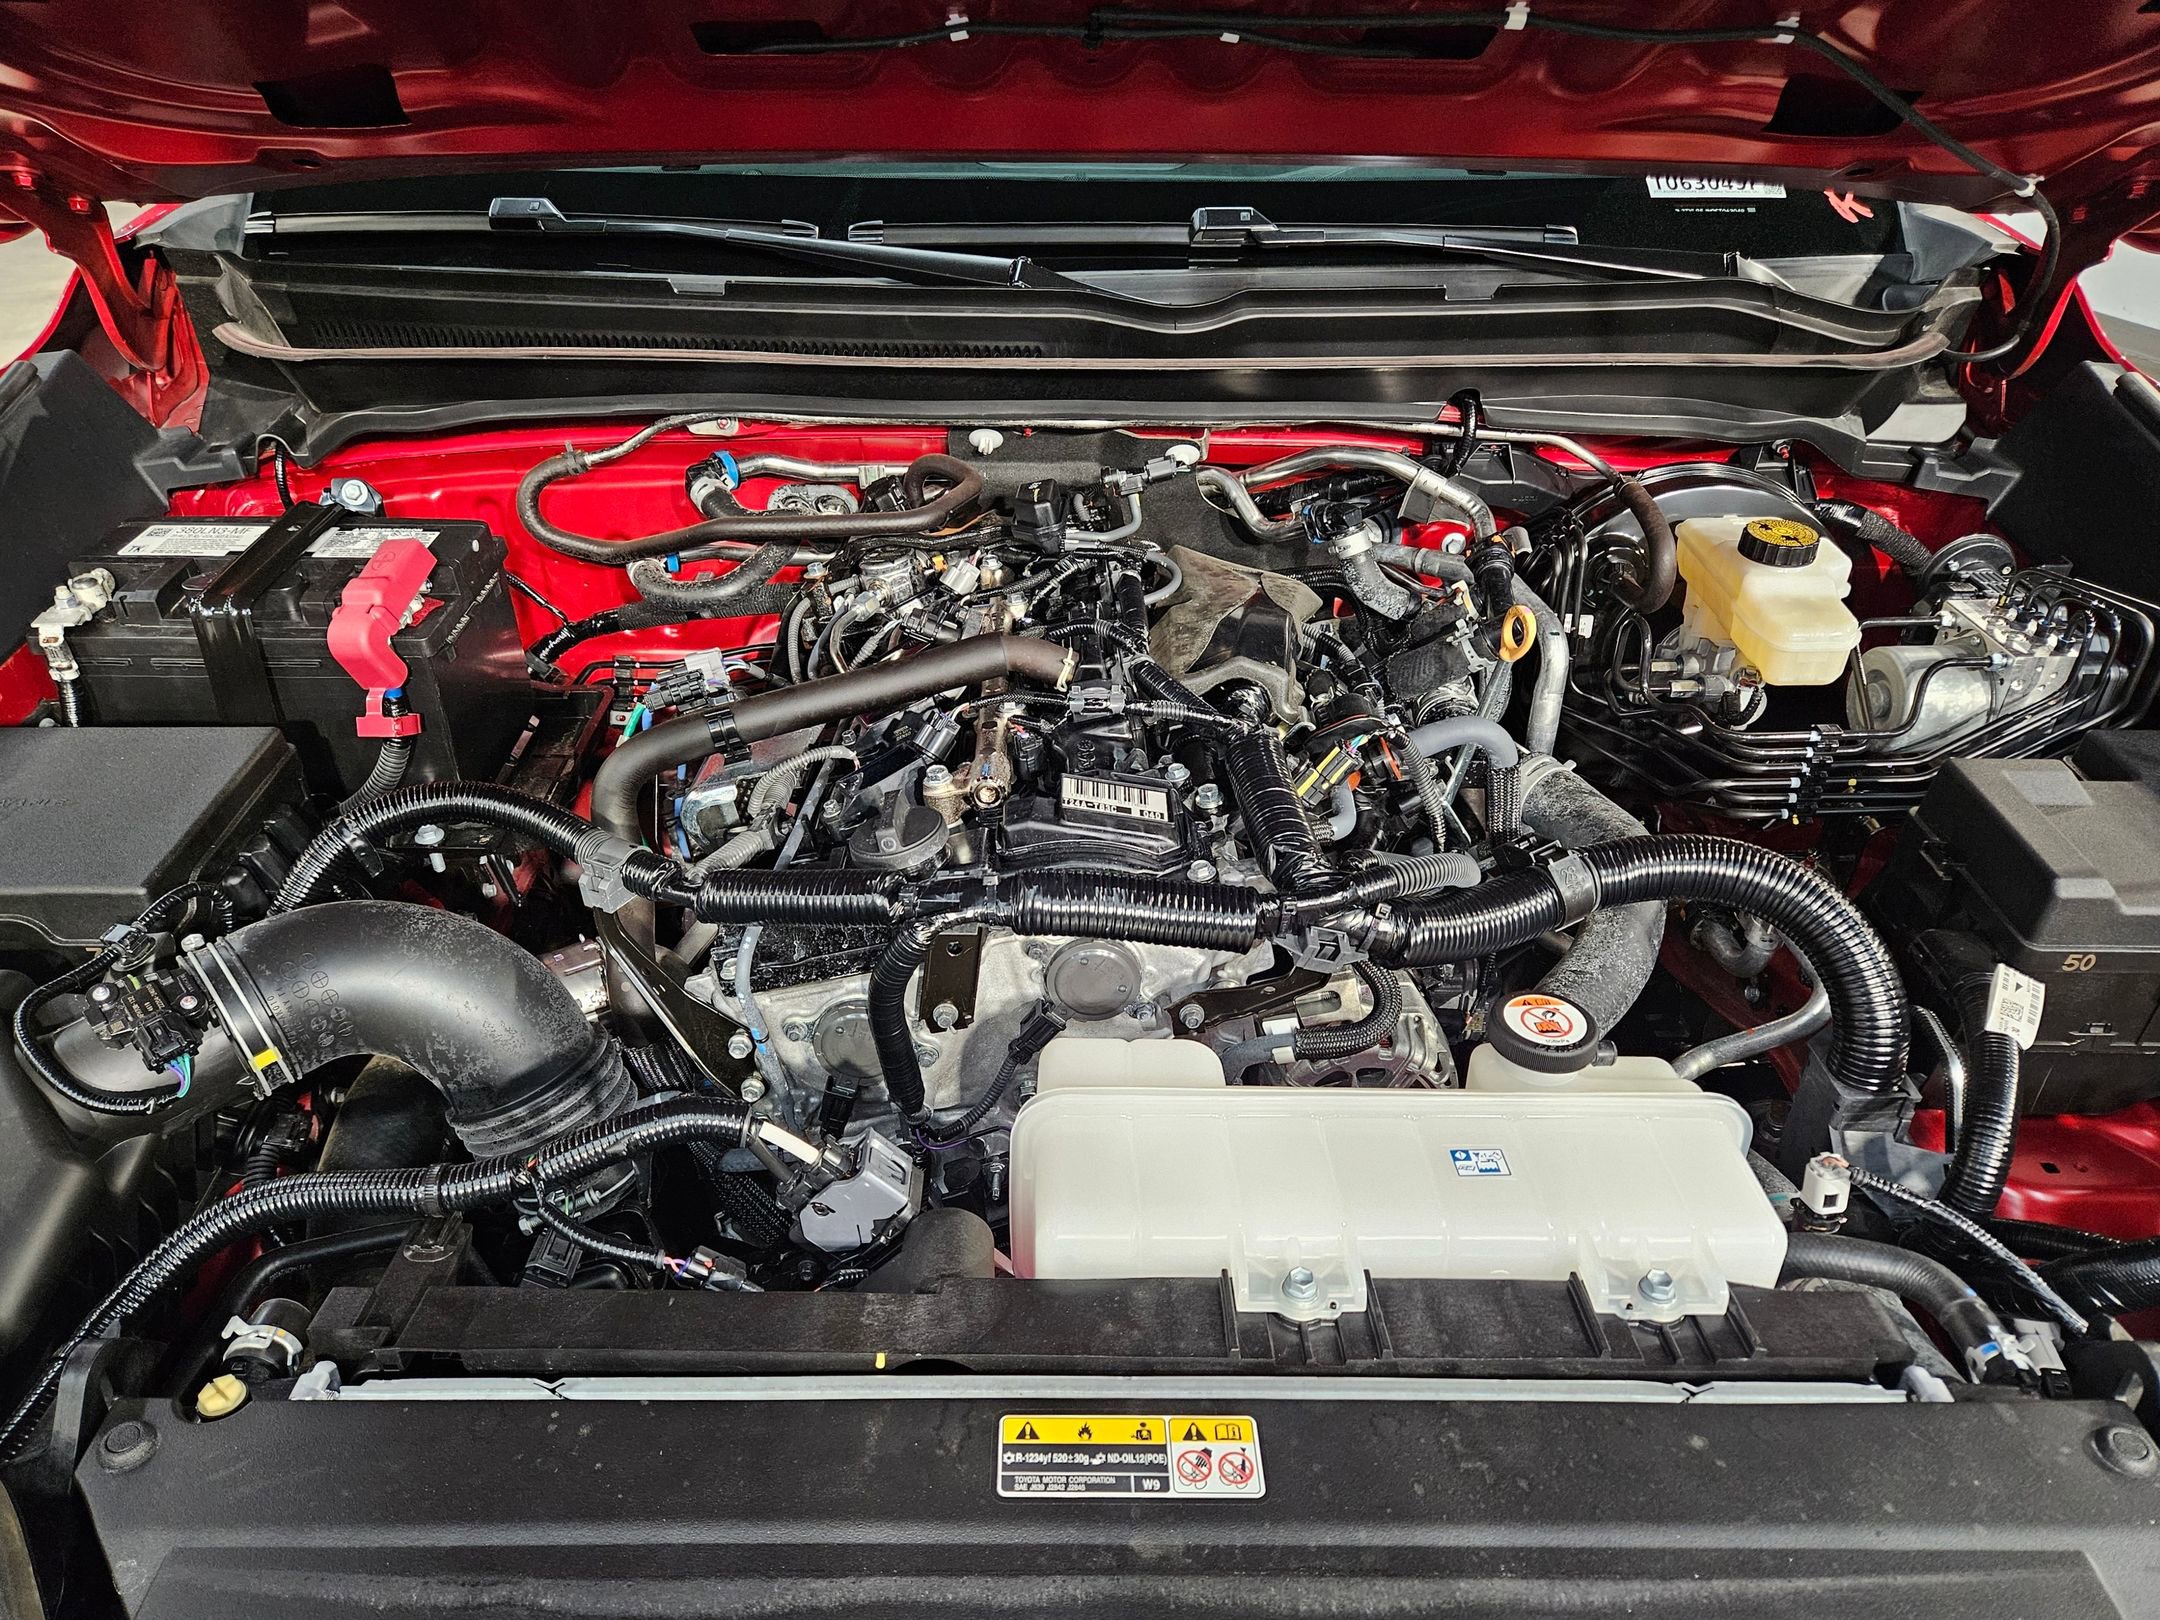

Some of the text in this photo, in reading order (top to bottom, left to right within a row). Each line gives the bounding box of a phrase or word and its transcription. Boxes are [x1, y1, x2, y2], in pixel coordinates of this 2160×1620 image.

[2061, 954, 2097, 972] 50
[1016, 1452, 1090, 1465] R-1234yf 520±30g
[1107, 1452, 1168, 1466] ND-OIL12(POE)
[1014, 1475, 1116, 1484] TOYOTA MOTOR CORPORATION
[1142, 1478, 1161, 1491] W9
